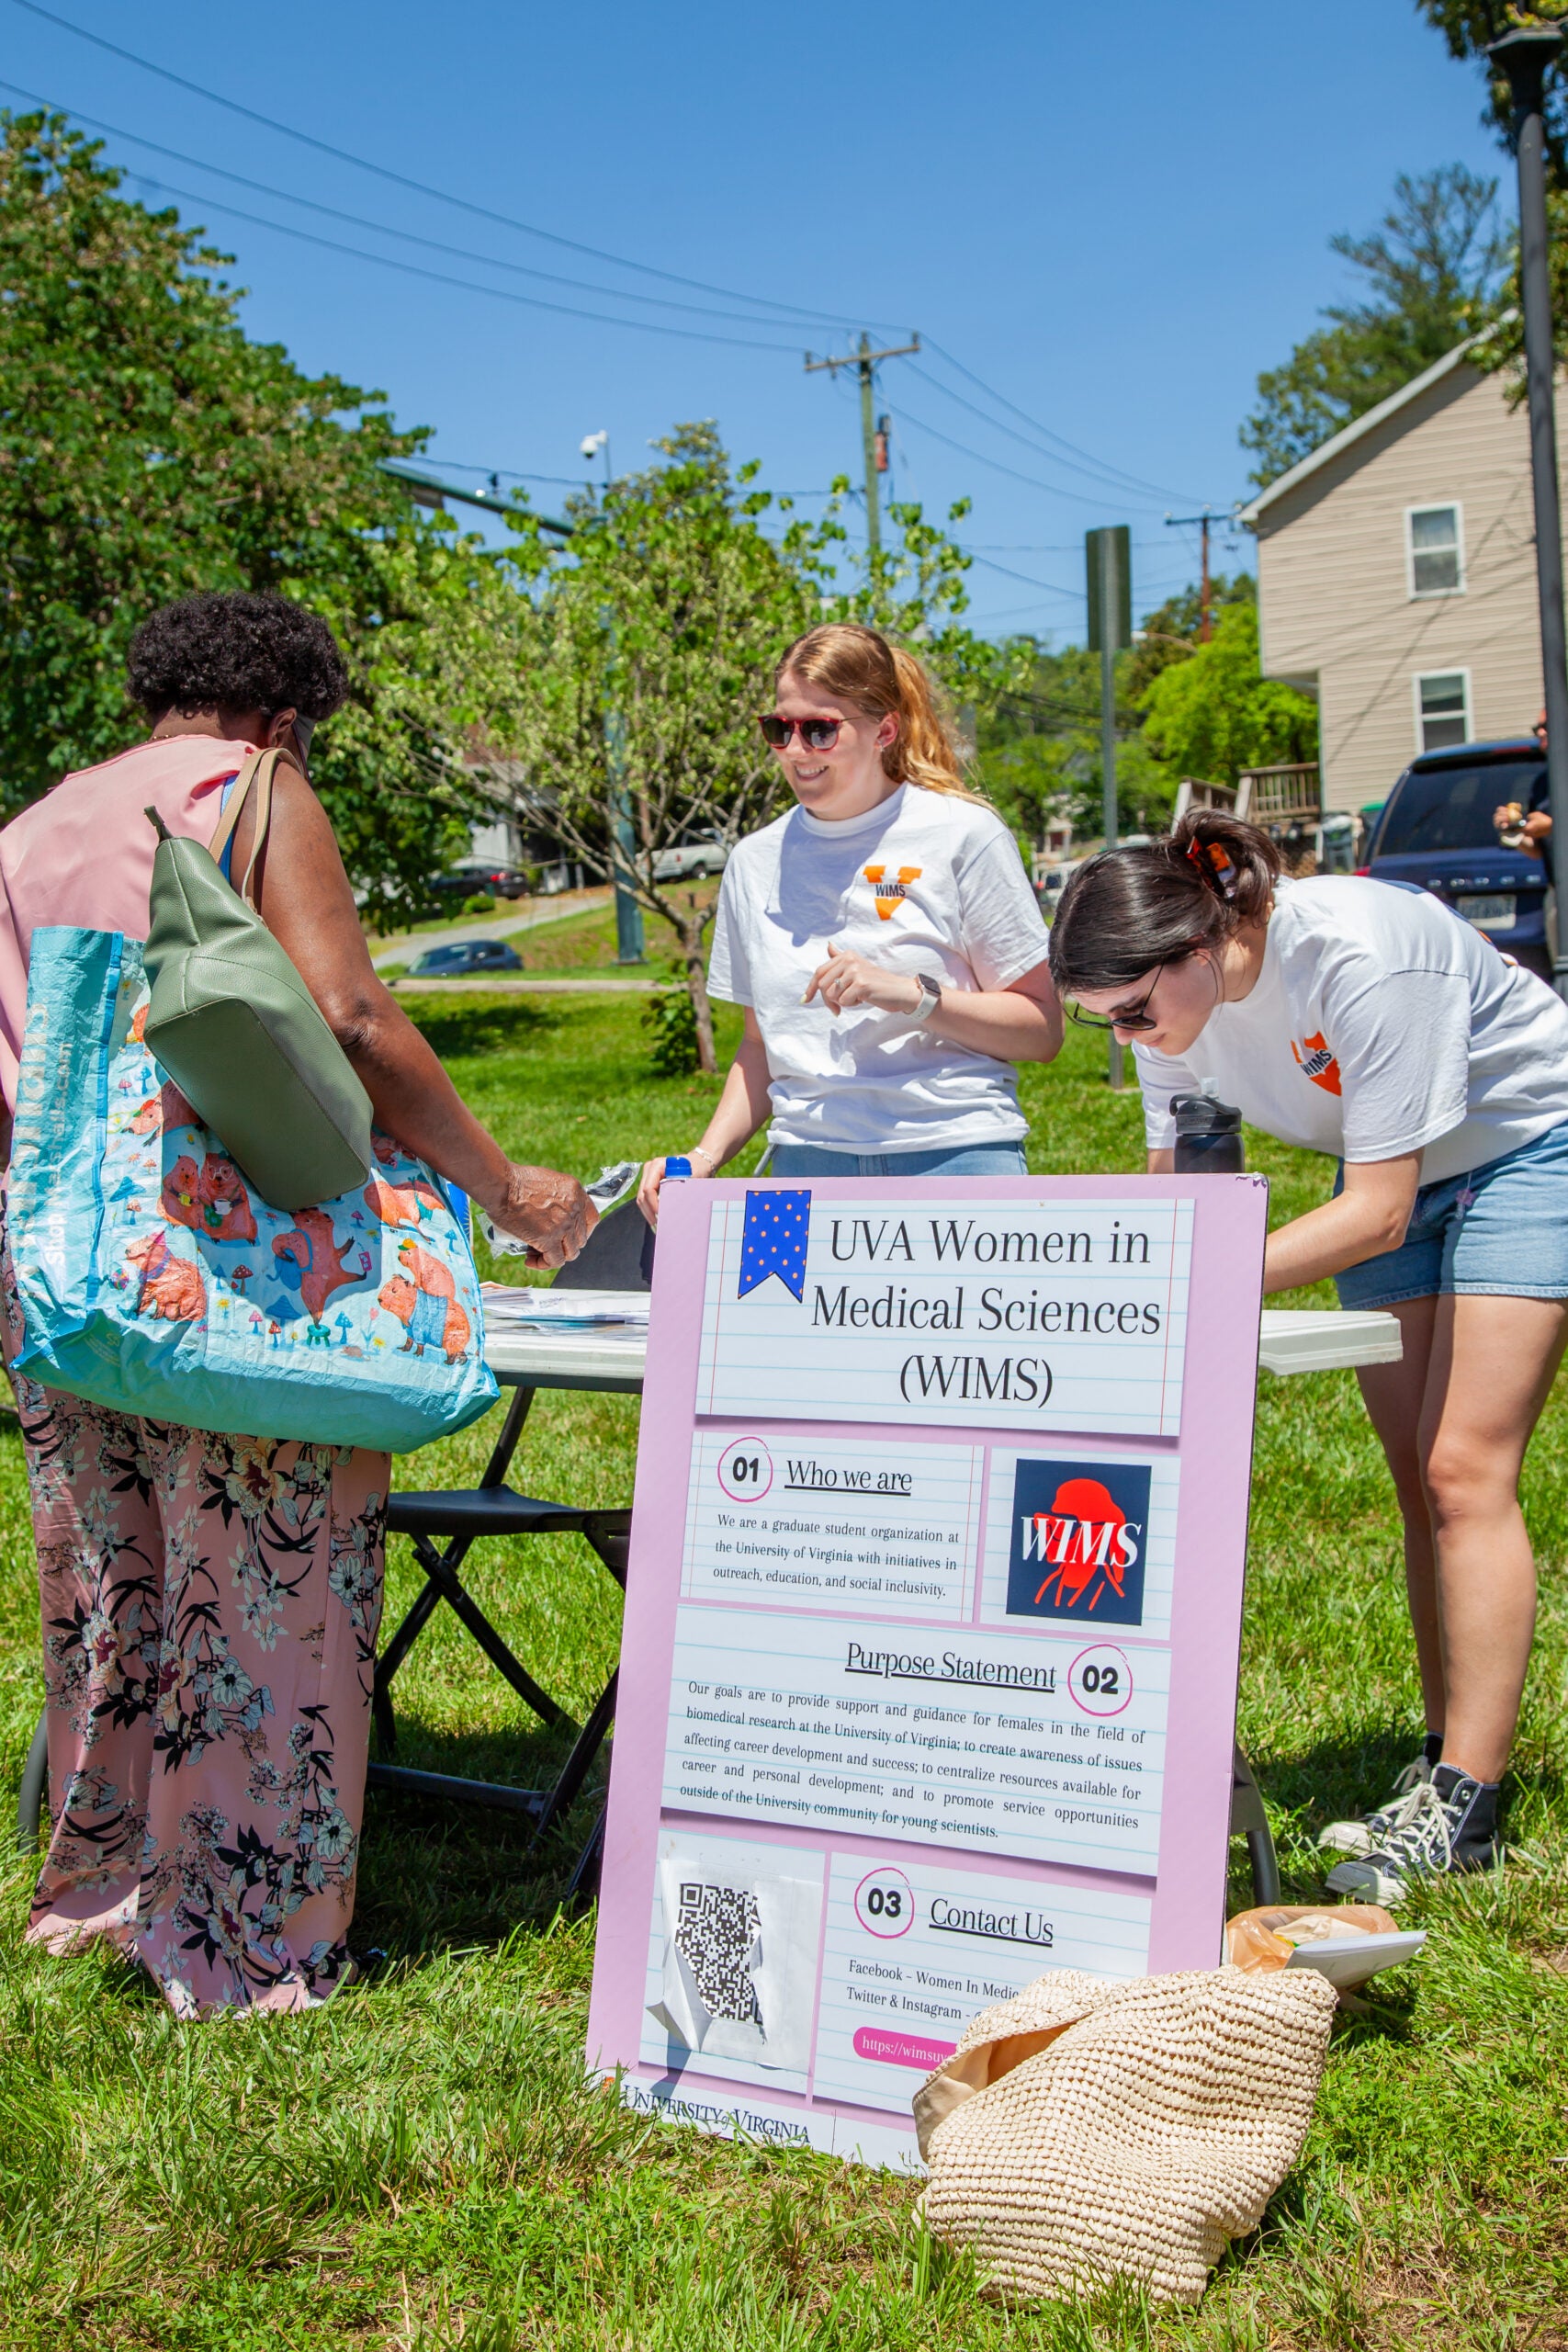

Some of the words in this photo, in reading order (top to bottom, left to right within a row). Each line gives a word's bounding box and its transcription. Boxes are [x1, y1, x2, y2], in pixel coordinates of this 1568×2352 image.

[875, 884, 906, 897] WIMS
[1300, 1049, 1333, 1076] WIMS
[45, 1214, 67, 1265] Shop
[831, 1220, 915, 1261] UVA
[929, 1220, 1092, 1263] Women
[1109, 1221, 1150, 1263] in
[811, 1285, 964, 1329] Medical
[978, 1288, 1160, 1334] Sciences
[900, 1355, 1053, 1408] (WIMS)
[732, 1456, 760, 1483] 01
[786, 1459, 839, 1487] Who
[841, 1471, 871, 1489] we
[876, 1472, 912, 1492] are
[718, 1514, 735, 1526] We
[739, 1520, 757, 1528] are
[761, 1521, 767, 1529] a
[773, 1520, 820, 1533] graduate
[826, 1523, 865, 1536] student
[871, 1527, 942, 1542] organization
[948, 1533, 958, 1543] at
[1021, 1516, 1142, 1567] WIMS
[716, 1540, 731, 1553] the
[737, 1542, 788, 1560] University
[794, 1546, 806, 1558] of
[809, 1547, 852, 1564] Virginia
[858, 1552, 880, 1564] with
[886, 1553, 940, 1568] initiatives
[946, 1557, 956, 1570] in
[713, 1568, 762, 1581] outreach,
[766, 1570, 821, 1587] education,
[825, 1576, 846, 1588] and
[850, 1578, 882, 1590] social
[886, 1579, 945, 1600] inclusivity.
[847, 1643, 934, 1679] Purpose
[941, 1651, 1056, 1689] Statement
[1082, 1665, 1118, 1695] 02
[689, 1681, 709, 1694] Our
[715, 1685, 742, 1699] goals
[749, 1690, 766, 1701] are
[772, 1692, 782, 1702] to
[788, 1694, 829, 1708] provide
[836, 1701, 878, 1715] support
[886, 1703, 907, 1716] and
[913, 1707, 966, 1724] guidance
[974, 1712, 991, 1725] for
[998, 1714, 1043, 1732] females
[1052, 1721, 1063, 1735] in
[1071, 1723, 1089, 1736] the
[1098, 1725, 1123, 1741] field
[1132, 1730, 1145, 1743] of
[686, 1706, 745, 1724] biomedical
[749, 1717, 795, 1730] research
[799, 1723, 809, 1733] at
[814, 1721, 830, 1735] the
[835, 1724, 889, 1745] University
[895, 1731, 908, 1744] of
[911, 1732, 960, 1751] Virginia;
[964, 1741, 976, 1752] to
[979, 1744, 1016, 1757] create
[1020, 1748, 1083, 1764] awareness
[1088, 1754, 1101, 1767] of
[1105, 1755, 1142, 1771] issues
[684, 1733, 731, 1752] affecting
[734, 1741, 769, 1753] career
[772, 1743, 842, 1763] development
[847, 1753, 868, 1766] and
[873, 1758, 918, 1773] success;
[922, 1763, 933, 1774] to
[937, 1766, 995, 1781] centralize
[1000, 1774, 1058, 1789] resources
[1063, 1781, 1117, 1796] available
[1122, 1785, 1141, 1800] for
[680, 1786, 718, 1799] outside
[721, 1789, 734, 1802] of
[736, 1791, 752, 1804] the
[756, 1792, 810, 1815] University
[814, 1804, 878, 1825] community
[882, 1810, 899, 1824] for
[902, 1815, 938, 1833] young
[941, 1820, 998, 1838] scientists.
[682, 1761, 716, 1773] career
[724, 1765, 744, 1777] and
[753, 1770, 800, 1784] personal
[808, 1773, 884, 1796] development;
[892, 1786, 914, 1799] and
[924, 1791, 934, 1802] to
[943, 1794, 994, 1809] promote
[1003, 1802, 1045, 1815] service
[1055, 1809, 1138, 1828] opportunities
[868, 1887, 901, 1918] 03
[931, 1898, 1018, 1943] Contact
[1025, 1912, 1054, 1943] Us
[850, 1960, 902, 1981] Facebook
[917, 1971, 962, 1991] Women
[966, 1980, 978, 1994] In
[847, 1986, 886, 2006] Twitter
[889, 1995, 897, 2007] &
[902, 1996, 961, 2019] Instagram
[862, 2035, 950, 2063] https://wimsuv
[624, 2085, 723, 2125] UNIVERSITY
[733, 2109, 810, 2143] VIRGINIA
